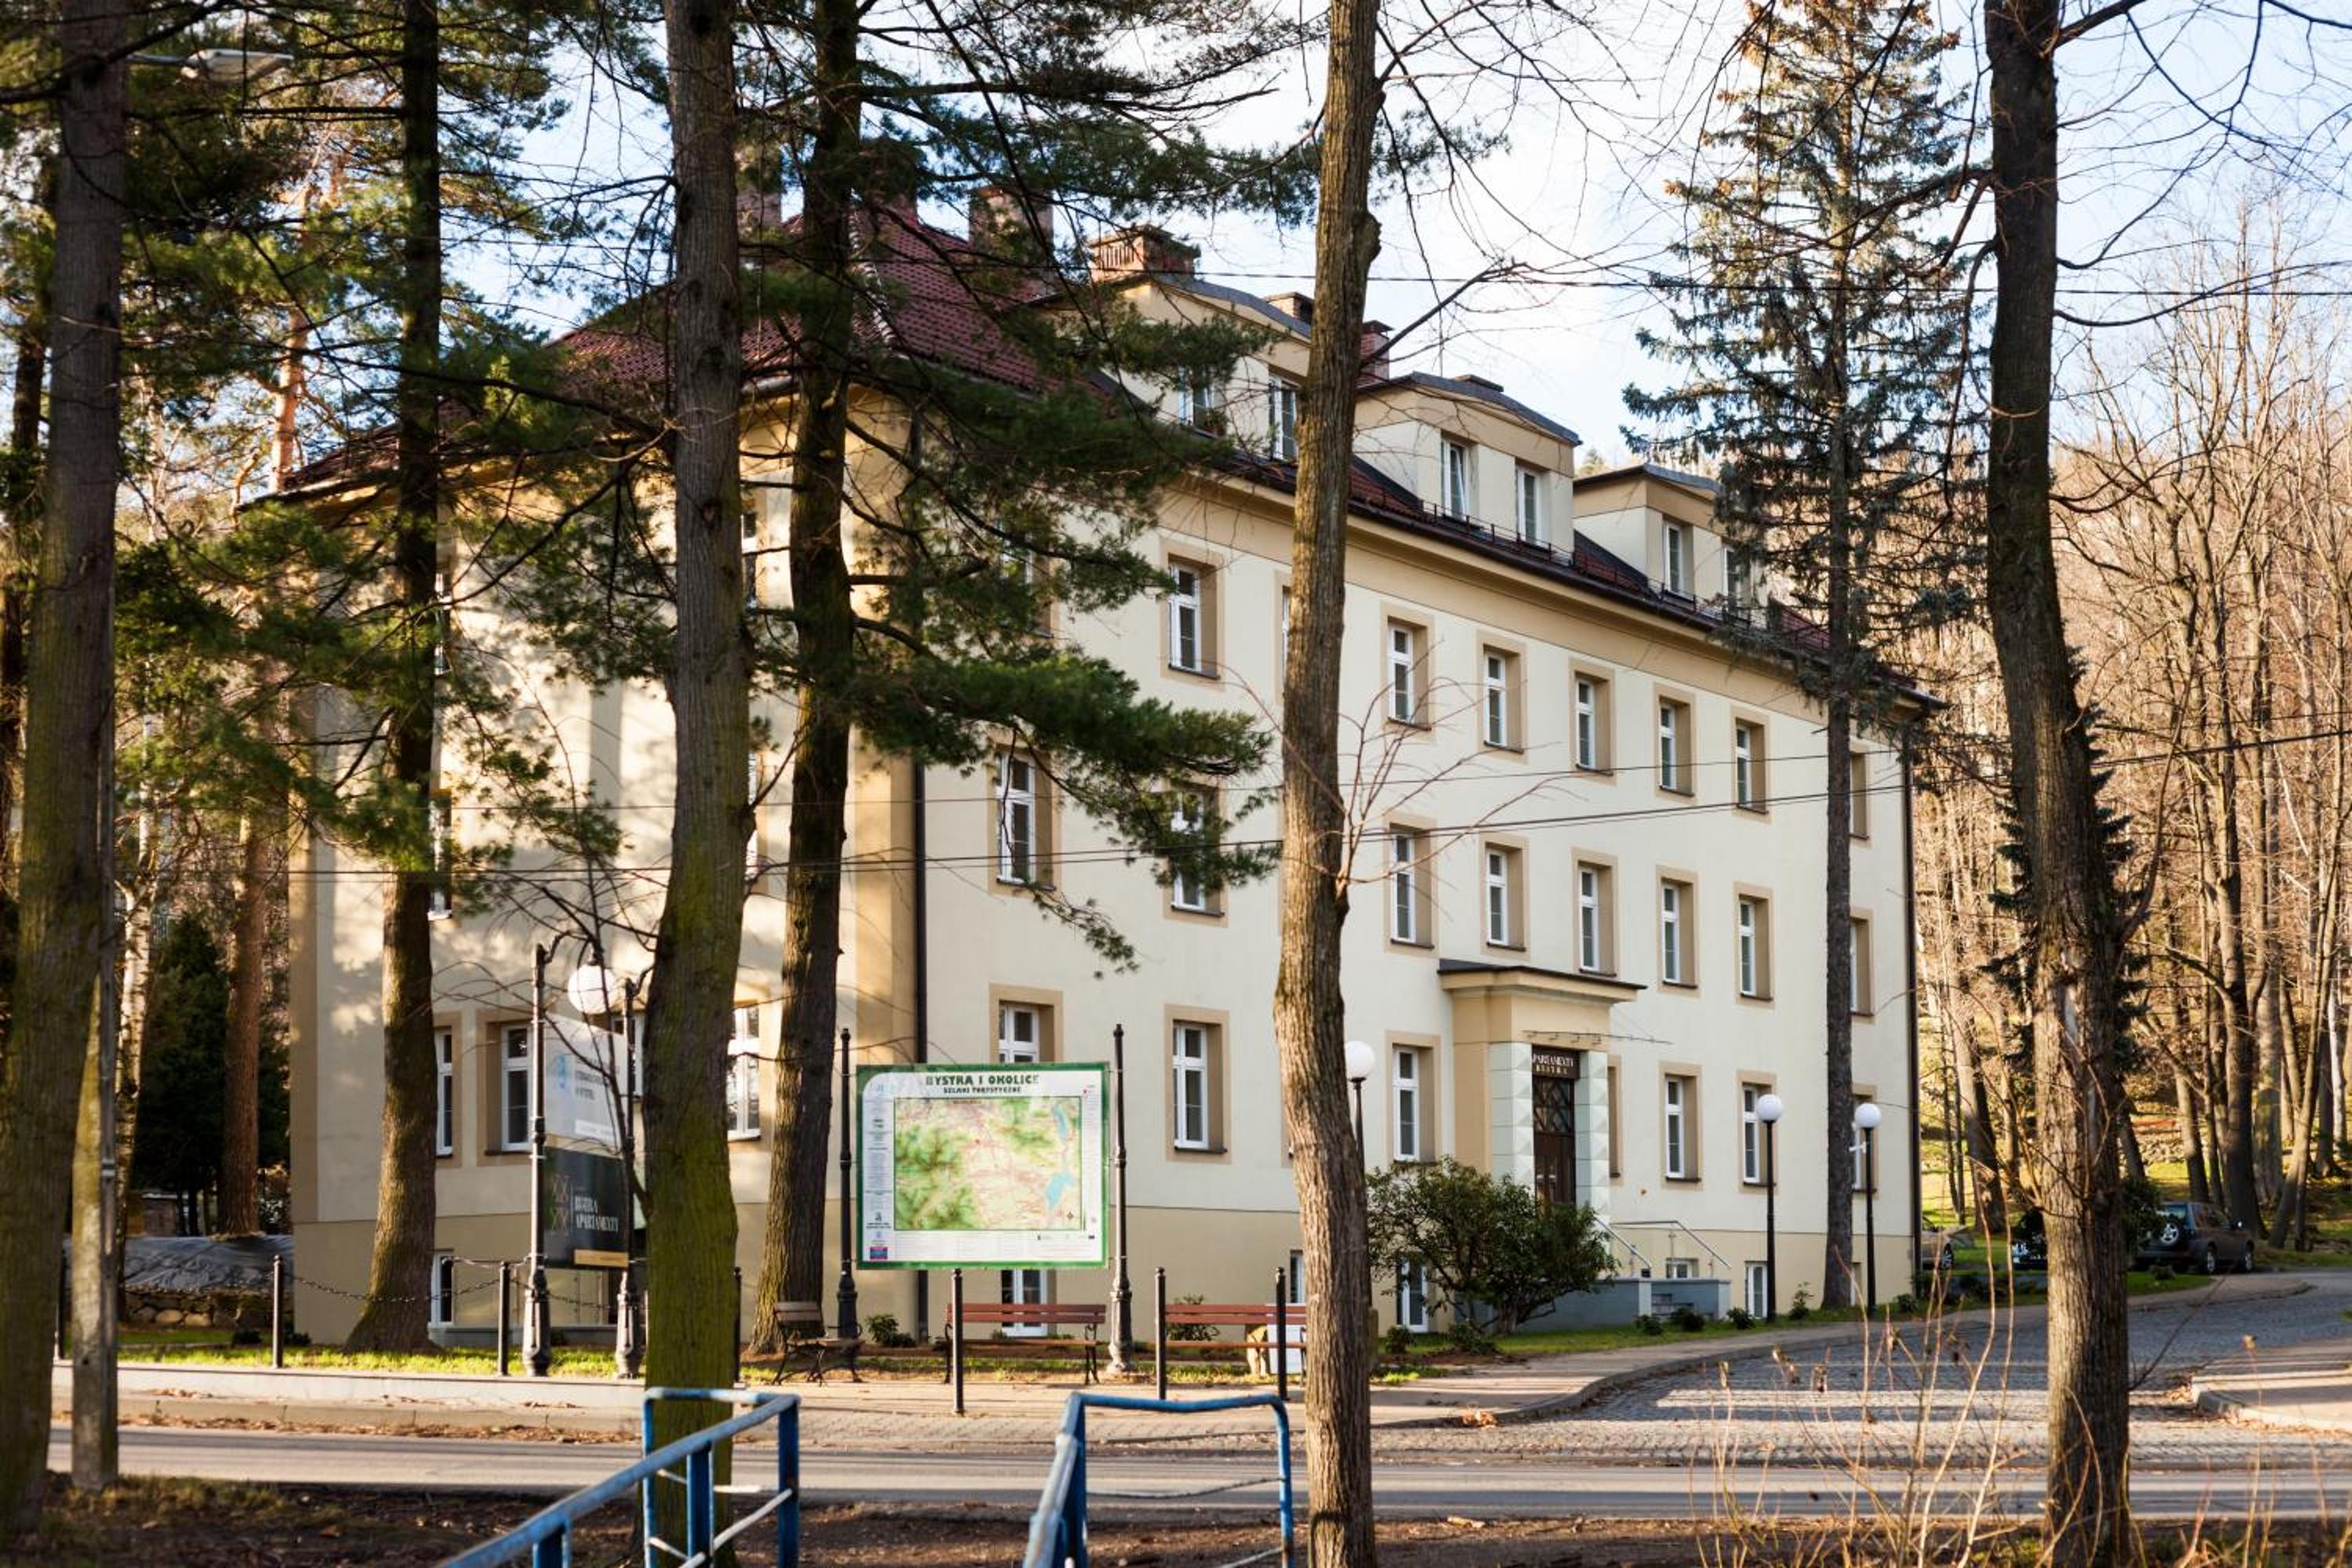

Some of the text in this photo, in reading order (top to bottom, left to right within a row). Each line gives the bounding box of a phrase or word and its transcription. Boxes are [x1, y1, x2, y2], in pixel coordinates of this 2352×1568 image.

[926, 1074, 1040, 1086] BYSTRA I OKOLICE
